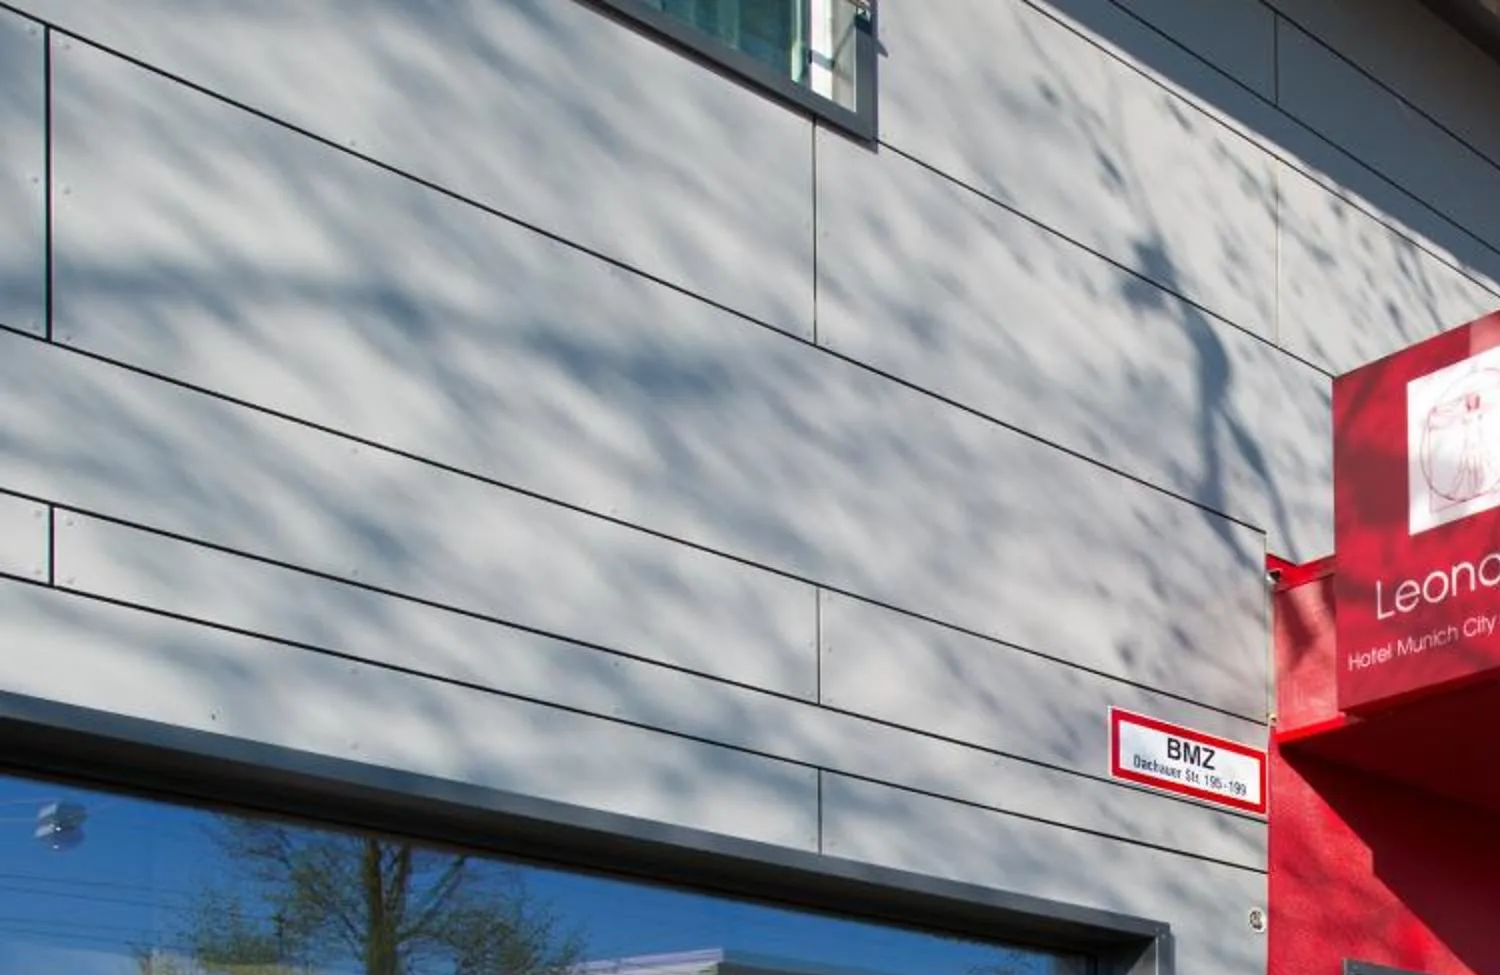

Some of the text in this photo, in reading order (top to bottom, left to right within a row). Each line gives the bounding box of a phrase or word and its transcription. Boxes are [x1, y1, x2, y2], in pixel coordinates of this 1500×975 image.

[1347, 643, 1393, 671] Hotel
[1396, 625, 1459, 657] Munich
[1463, 615, 1498, 637] City
[1133, 754, 1181, 779] Dachauer
[1167, 737, 1215, 770] BMZ
